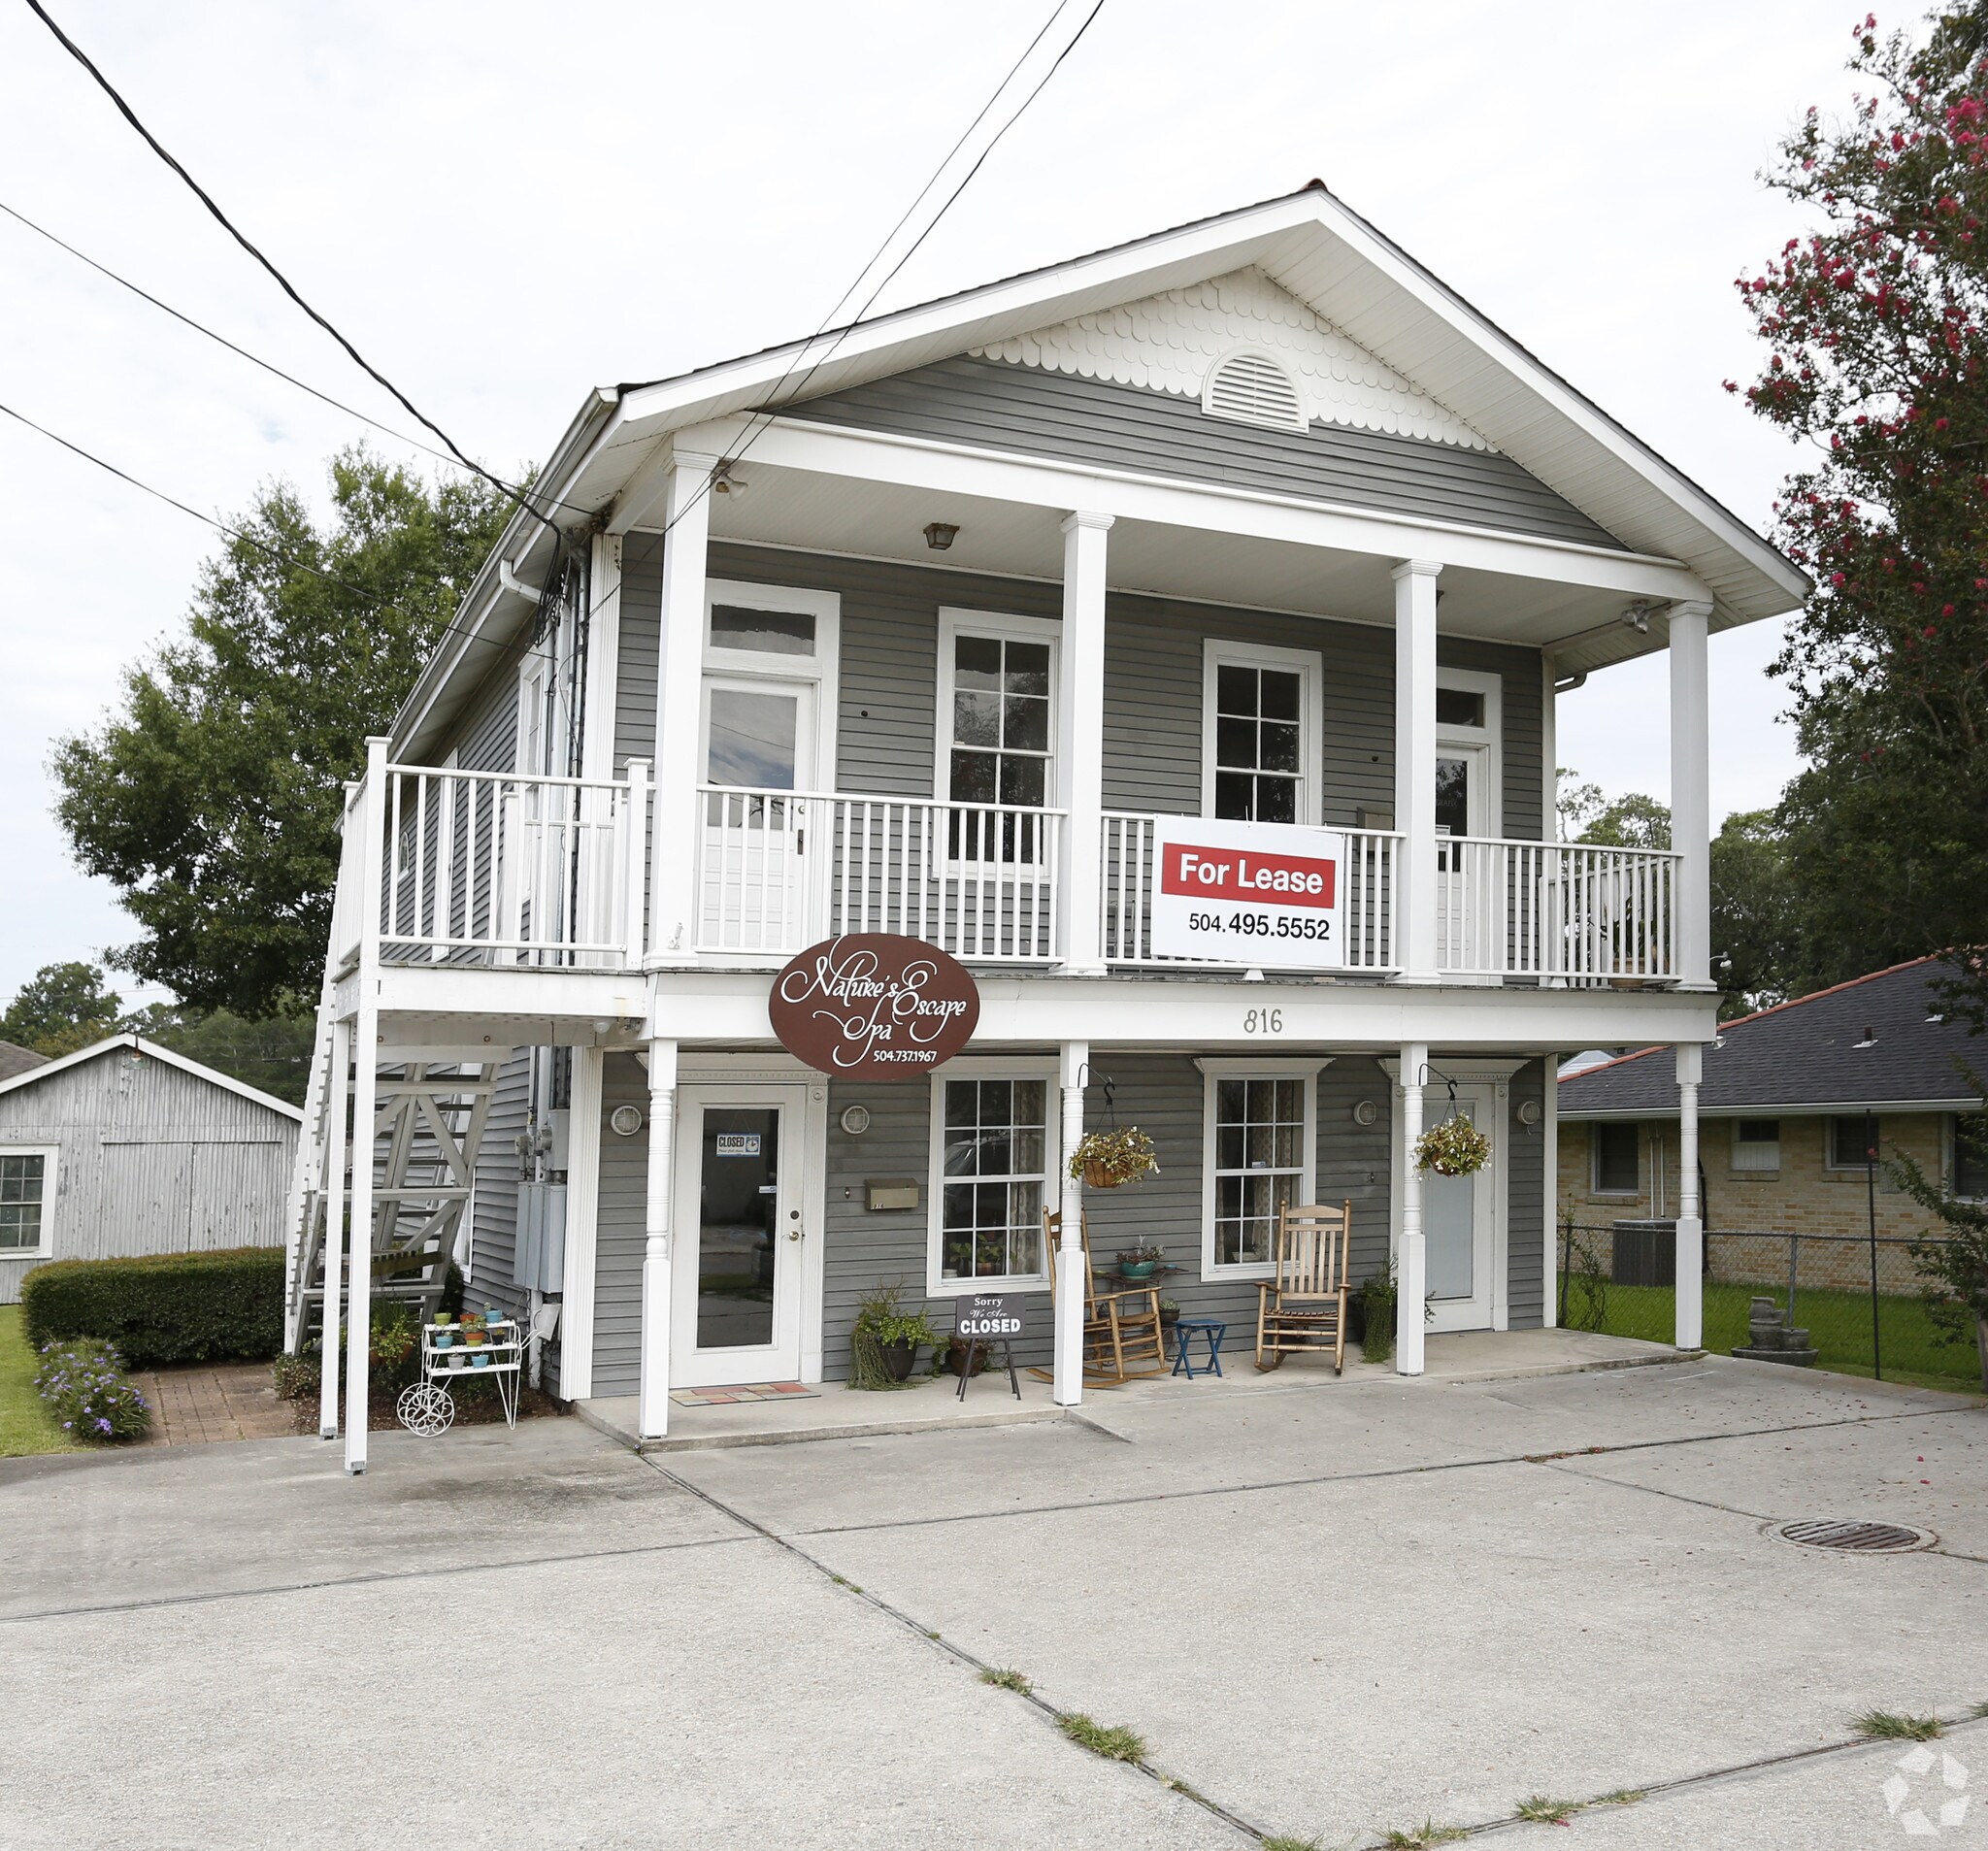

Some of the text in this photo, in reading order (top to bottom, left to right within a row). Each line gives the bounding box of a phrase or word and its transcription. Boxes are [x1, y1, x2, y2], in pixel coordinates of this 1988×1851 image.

[1179, 852, 1324, 895] For Lease
[780, 935, 967, 1042] Nature's Escape
[812, 993, 892, 1067] Spa
[1243, 1008, 1283, 1034] 816
[718, 1137, 745, 1148] CLOSED
[974, 1297, 1004, 1307] Sorry
[969, 1308, 1008, 1319] We Are
[960, 1318, 1021, 1335] CLOSED
